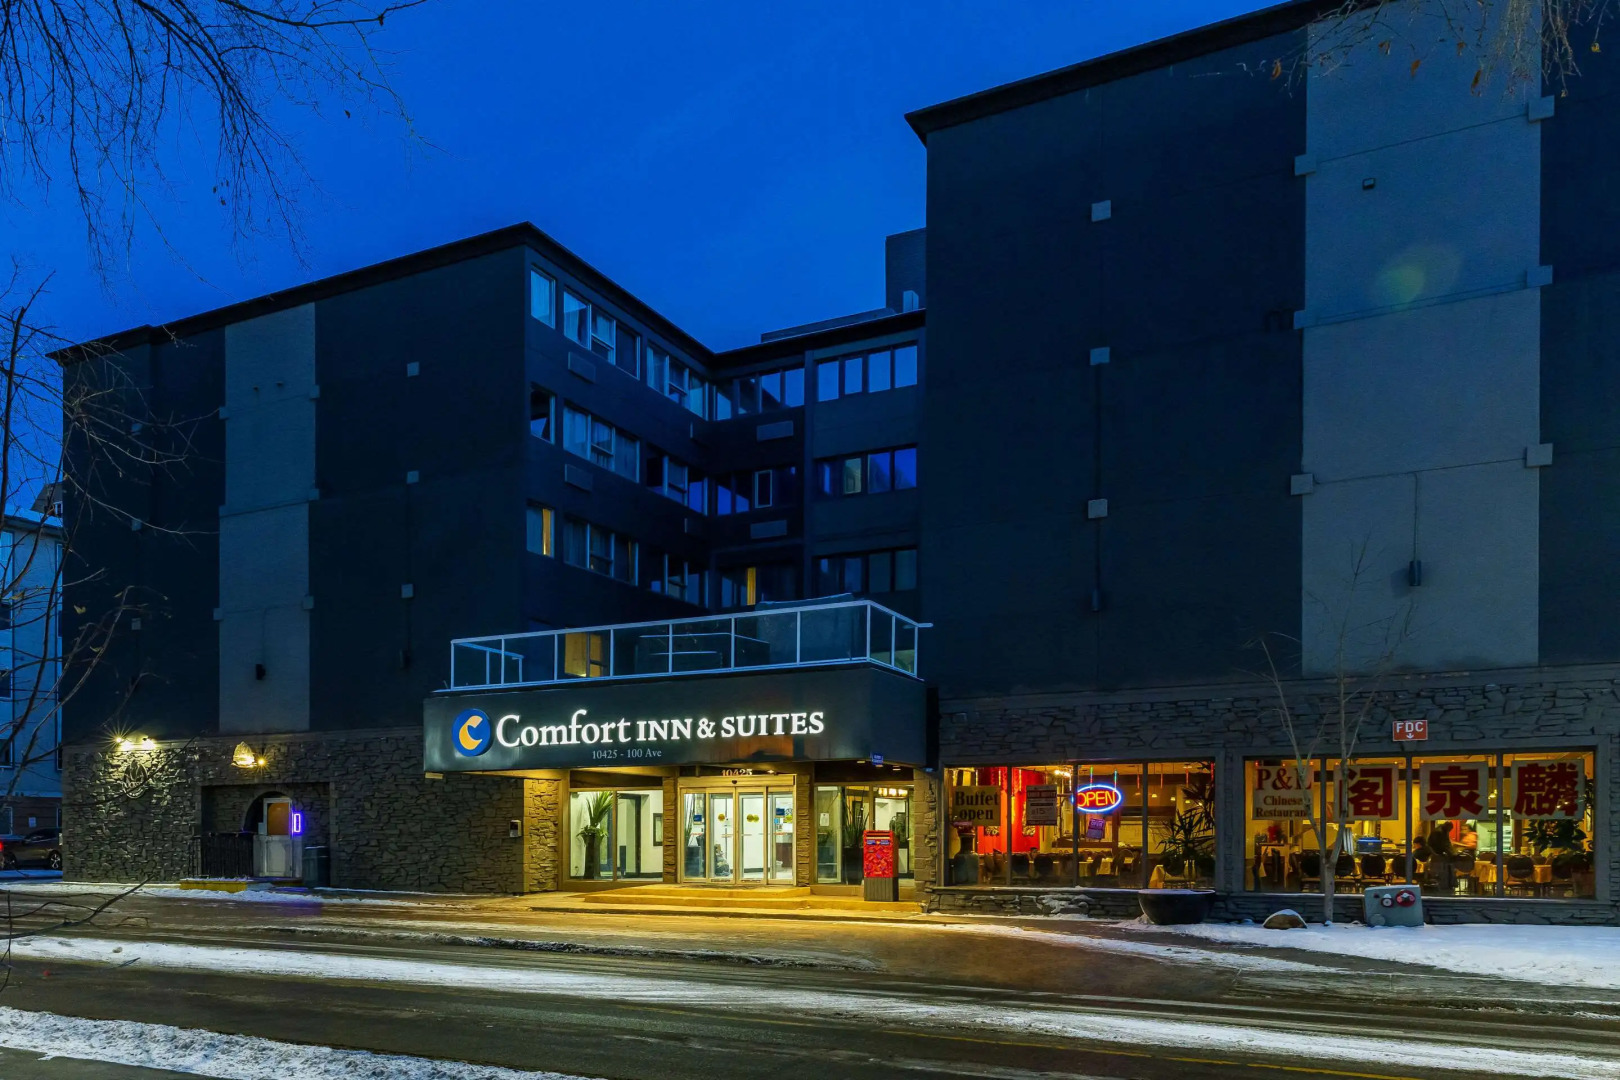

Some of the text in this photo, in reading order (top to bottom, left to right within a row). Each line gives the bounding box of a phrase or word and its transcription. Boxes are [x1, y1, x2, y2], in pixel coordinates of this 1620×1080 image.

[496, 709, 631, 748] Comfort
[636, 719, 692, 742] INN
[697, 717, 717, 739] &
[721, 711, 824, 737] SUITES
[1396, 721, 1424, 733] FDC
[592, 750, 618, 760] 10425
[627, 748, 643, 758] 100
[645, 748, 662, 758] Ave
[721, 768, 753, 777] 10425
[955, 791, 999, 806] Buffet
[1077, 790, 1116, 807] OPEN
[1263, 795, 1303, 806] Chinese
[959, 809, 994, 822] open
[1255, 807, 1307, 818] Restauran
